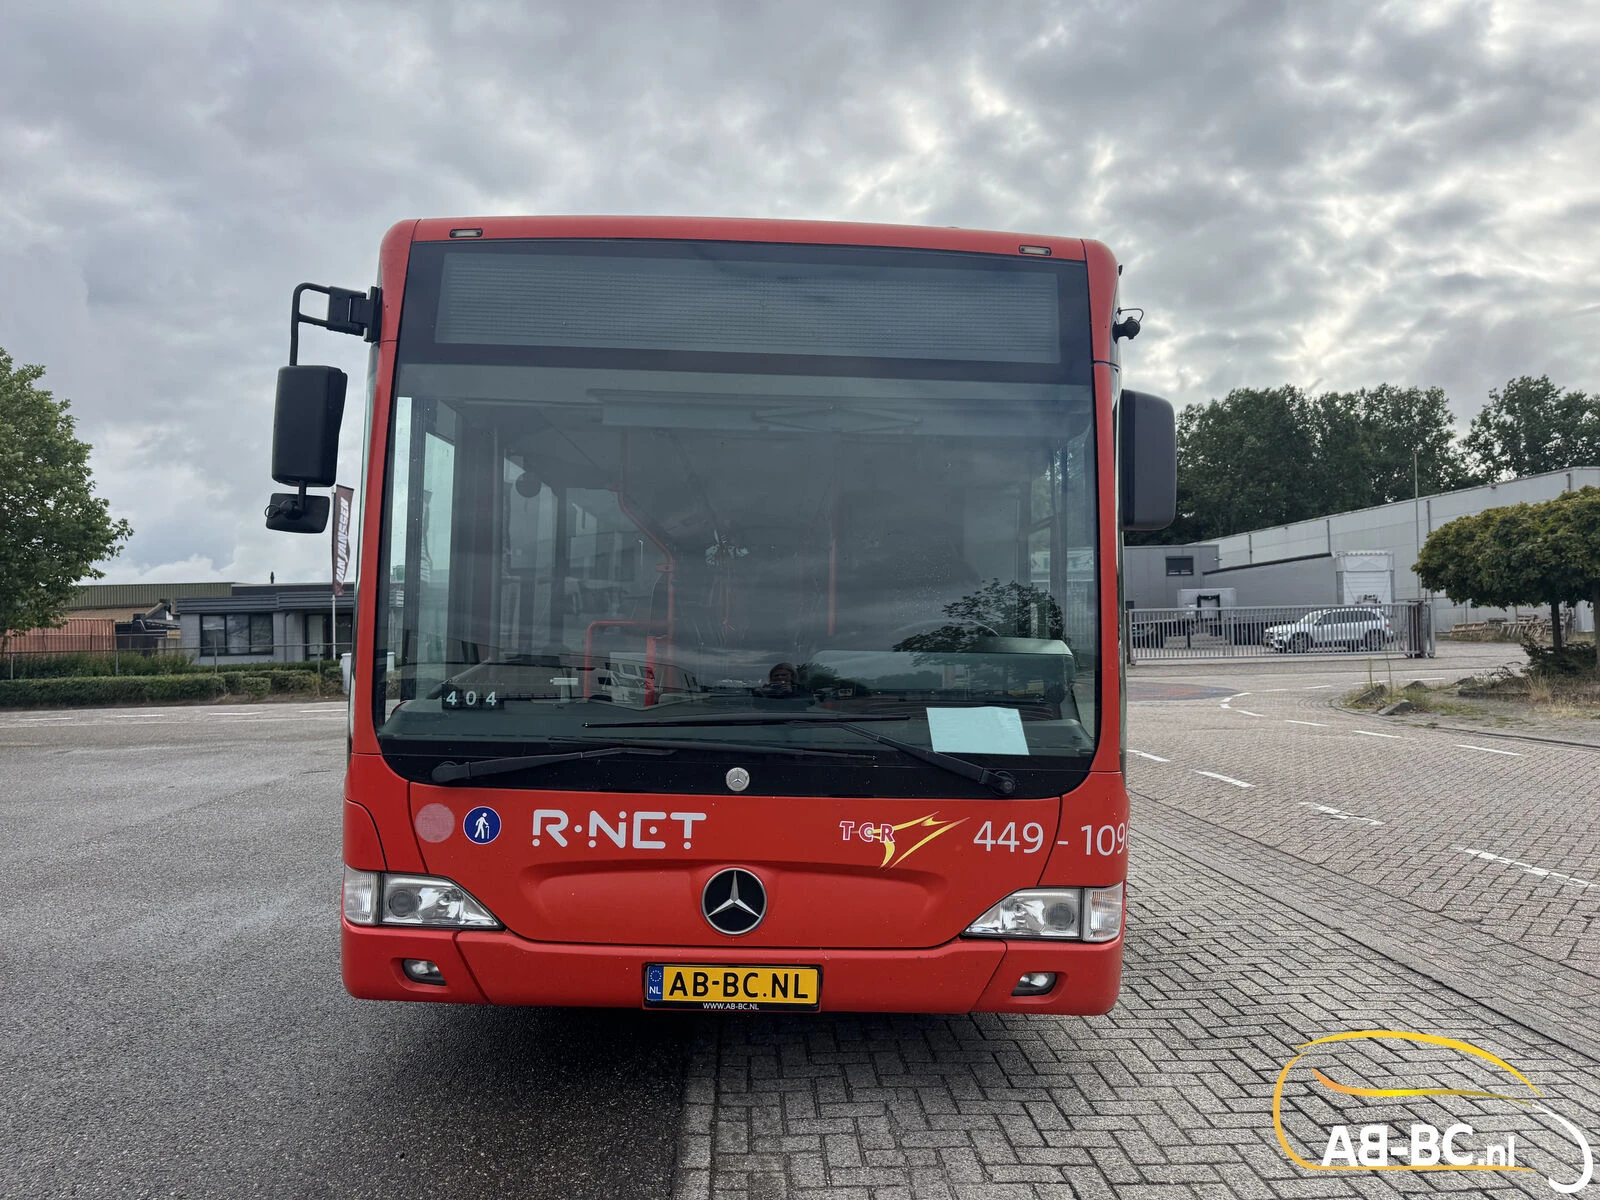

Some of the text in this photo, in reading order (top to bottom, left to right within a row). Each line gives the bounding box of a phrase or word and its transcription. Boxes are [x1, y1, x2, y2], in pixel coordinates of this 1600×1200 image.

[839, 820, 896, 843] TCR
[973, 820, 1044, 854] 449
[649, 986, 662, 995] NL
[668, 971, 809, 999] AB-BC.NL
[702, 1002, 760, 1011] WWW.AB-BC.NL
